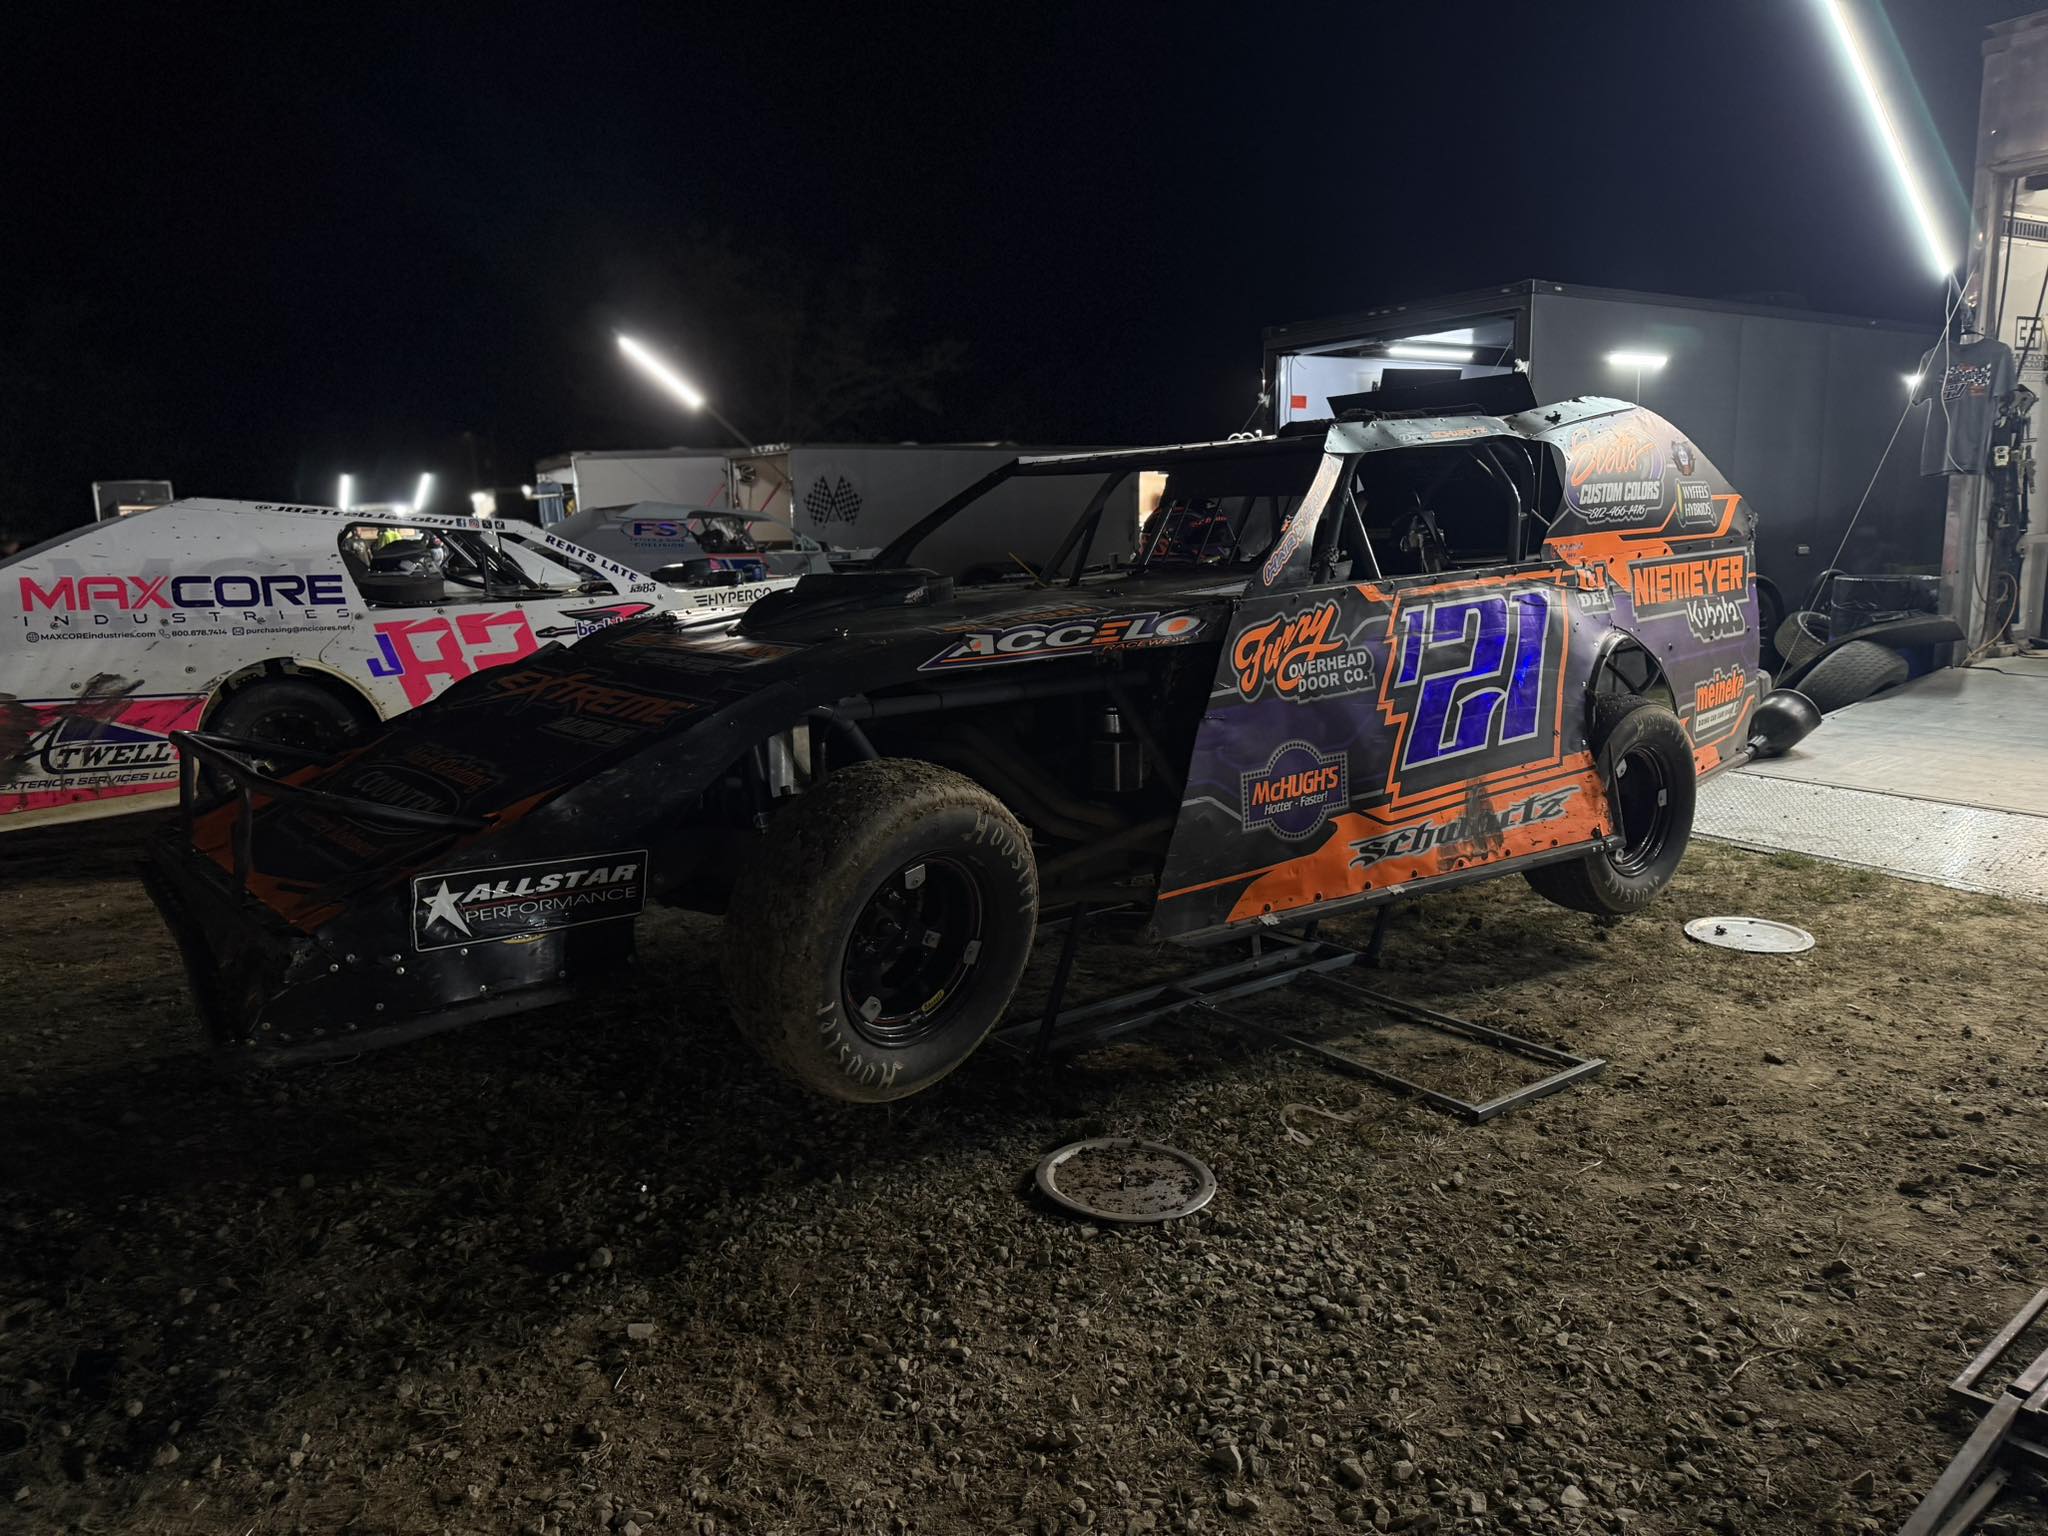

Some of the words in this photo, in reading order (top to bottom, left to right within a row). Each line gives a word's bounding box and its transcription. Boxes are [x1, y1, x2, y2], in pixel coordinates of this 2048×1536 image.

[1579, 483, 1622, 505] CUSTOM
[1624, 481, 1660, 501] COLORS
[1682, 485, 1709, 500] WYFFELS
[1684, 502, 1711, 518] HYBRIDS
[634, 523, 677, 537] FS
[545, 535, 597, 563] RENTS
[601, 560, 638, 582] LATE
[19, 575, 347, 612] MAXCORE
[1633, 555, 1744, 607] NIEMEYER
[23, 609, 353, 627] INDUSTRIES
[1687, 596, 1739, 628] Kubota
[40, 630, 157, 641] MAXCOREindustries.com
[245, 624, 352, 636] purchasing@mcicores.net
[945, 614, 1202, 655] ACCELO
[1288, 651, 1367, 679] OVERHEAD
[1298, 672, 1340, 693] DOOR
[1344, 668, 1368, 684] CO.
[1696, 669, 1744, 712] meineke
[0, 778, 74, 792] EXTERIOR
[77, 773, 149, 786] SERVICES
[152, 770, 178, 780] LLC
[1251, 766, 1340, 806] McHUGH'S
[1264, 801, 1294, 815] Hotter
[1300, 790, 1328, 808] Faster!
[461, 864, 638, 904] ALLSTAR
[465, 886, 637, 923] PERFORMANCE
